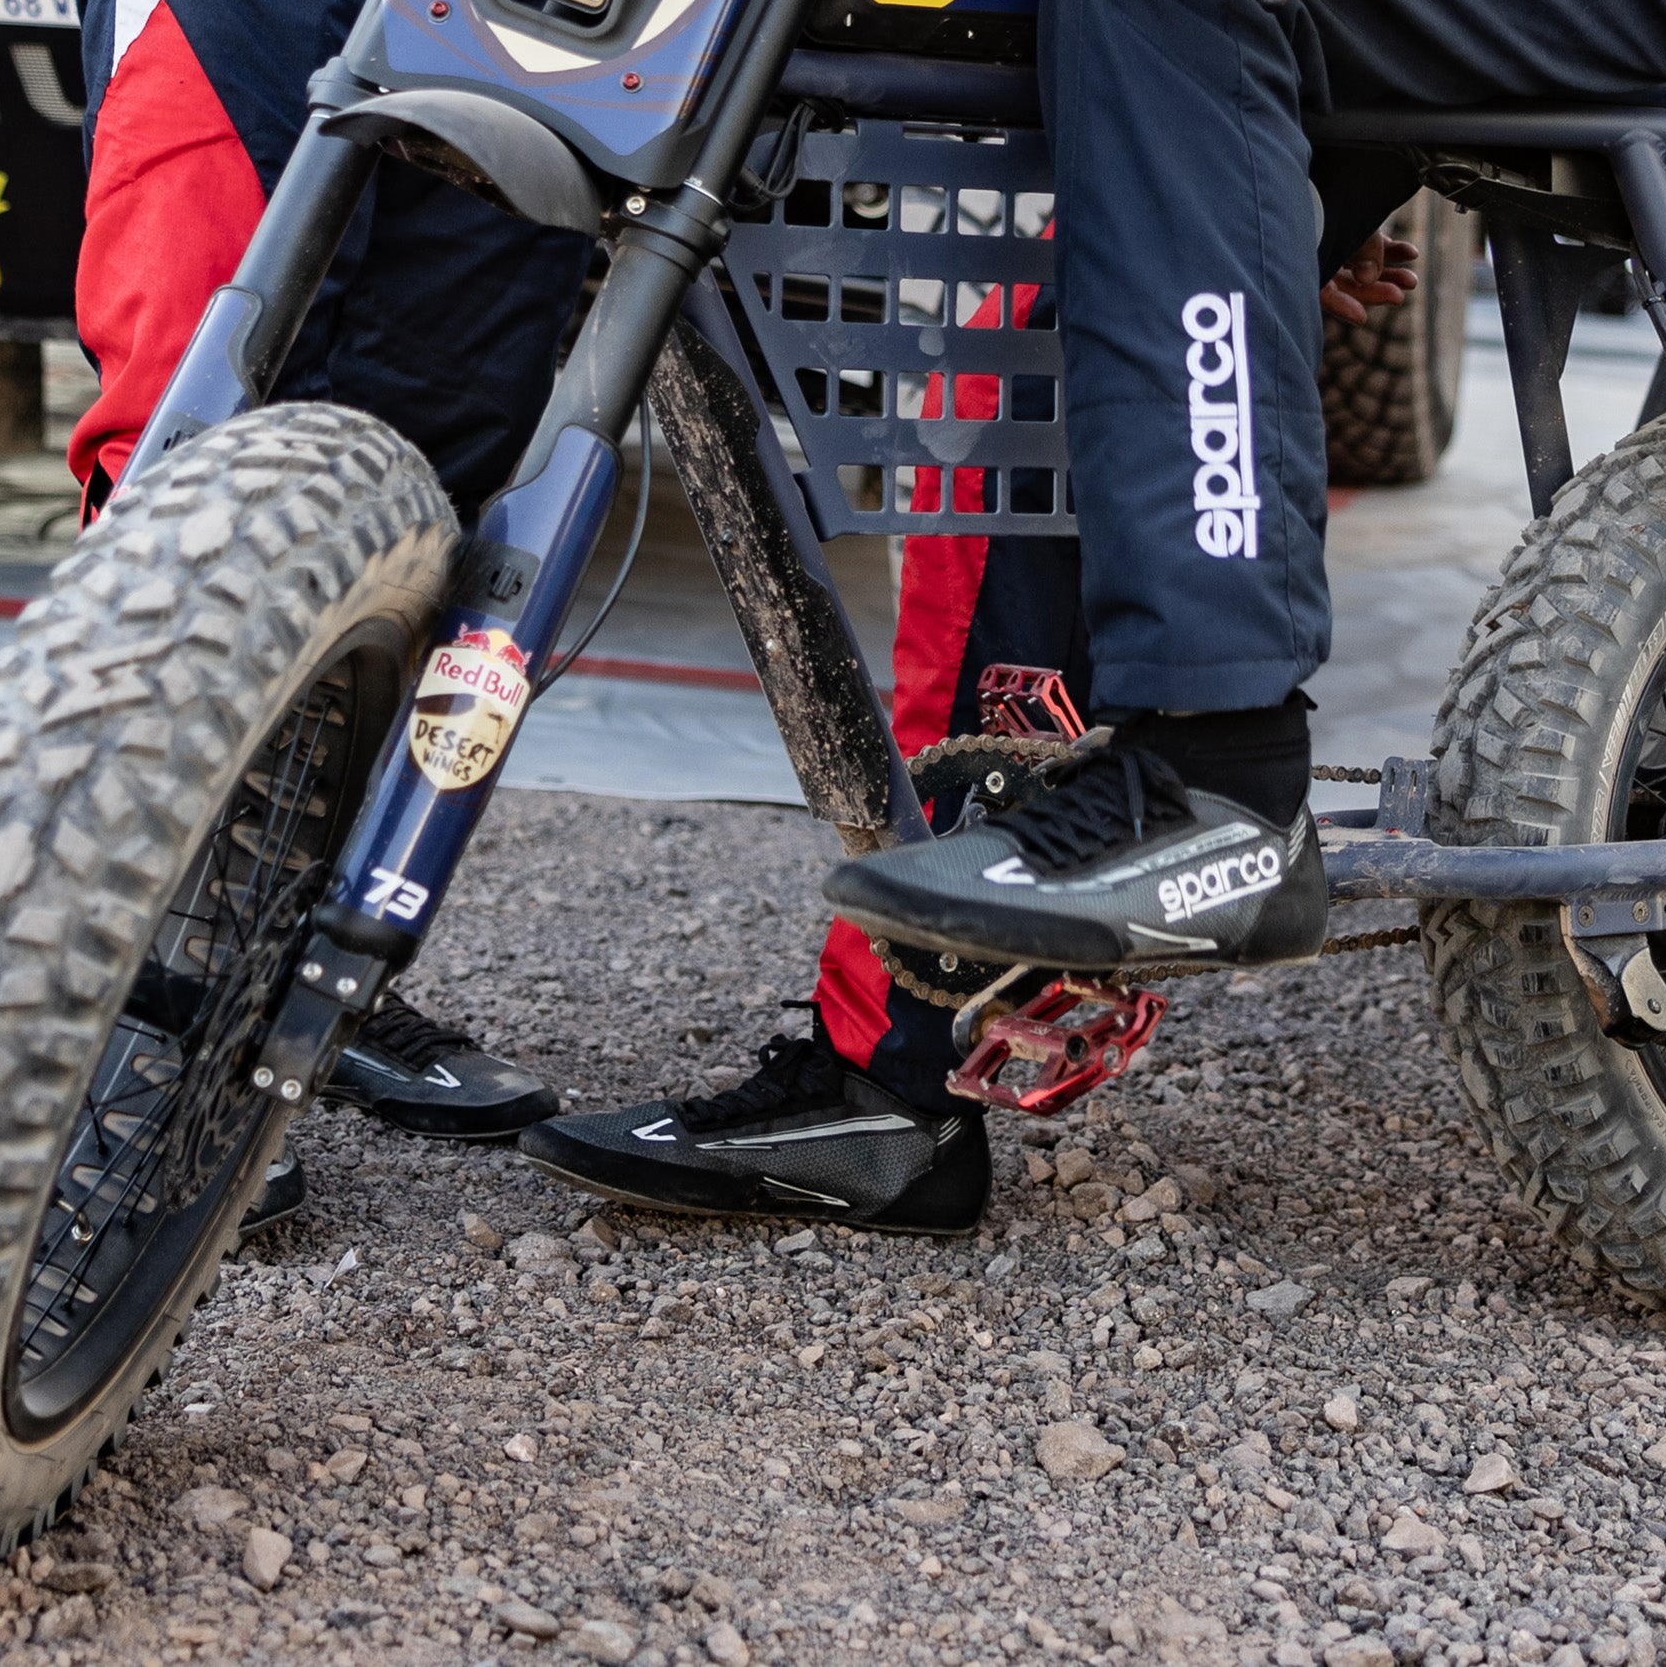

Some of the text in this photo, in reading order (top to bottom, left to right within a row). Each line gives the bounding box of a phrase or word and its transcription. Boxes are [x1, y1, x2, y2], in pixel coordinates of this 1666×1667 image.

[1180, 290, 1259, 559] sparco
[434, 652, 525, 708] Red Bull
[414, 718, 496, 768] DESERT
[362, 865, 431, 923] 73
[1157, 845, 1283, 924] sparco
